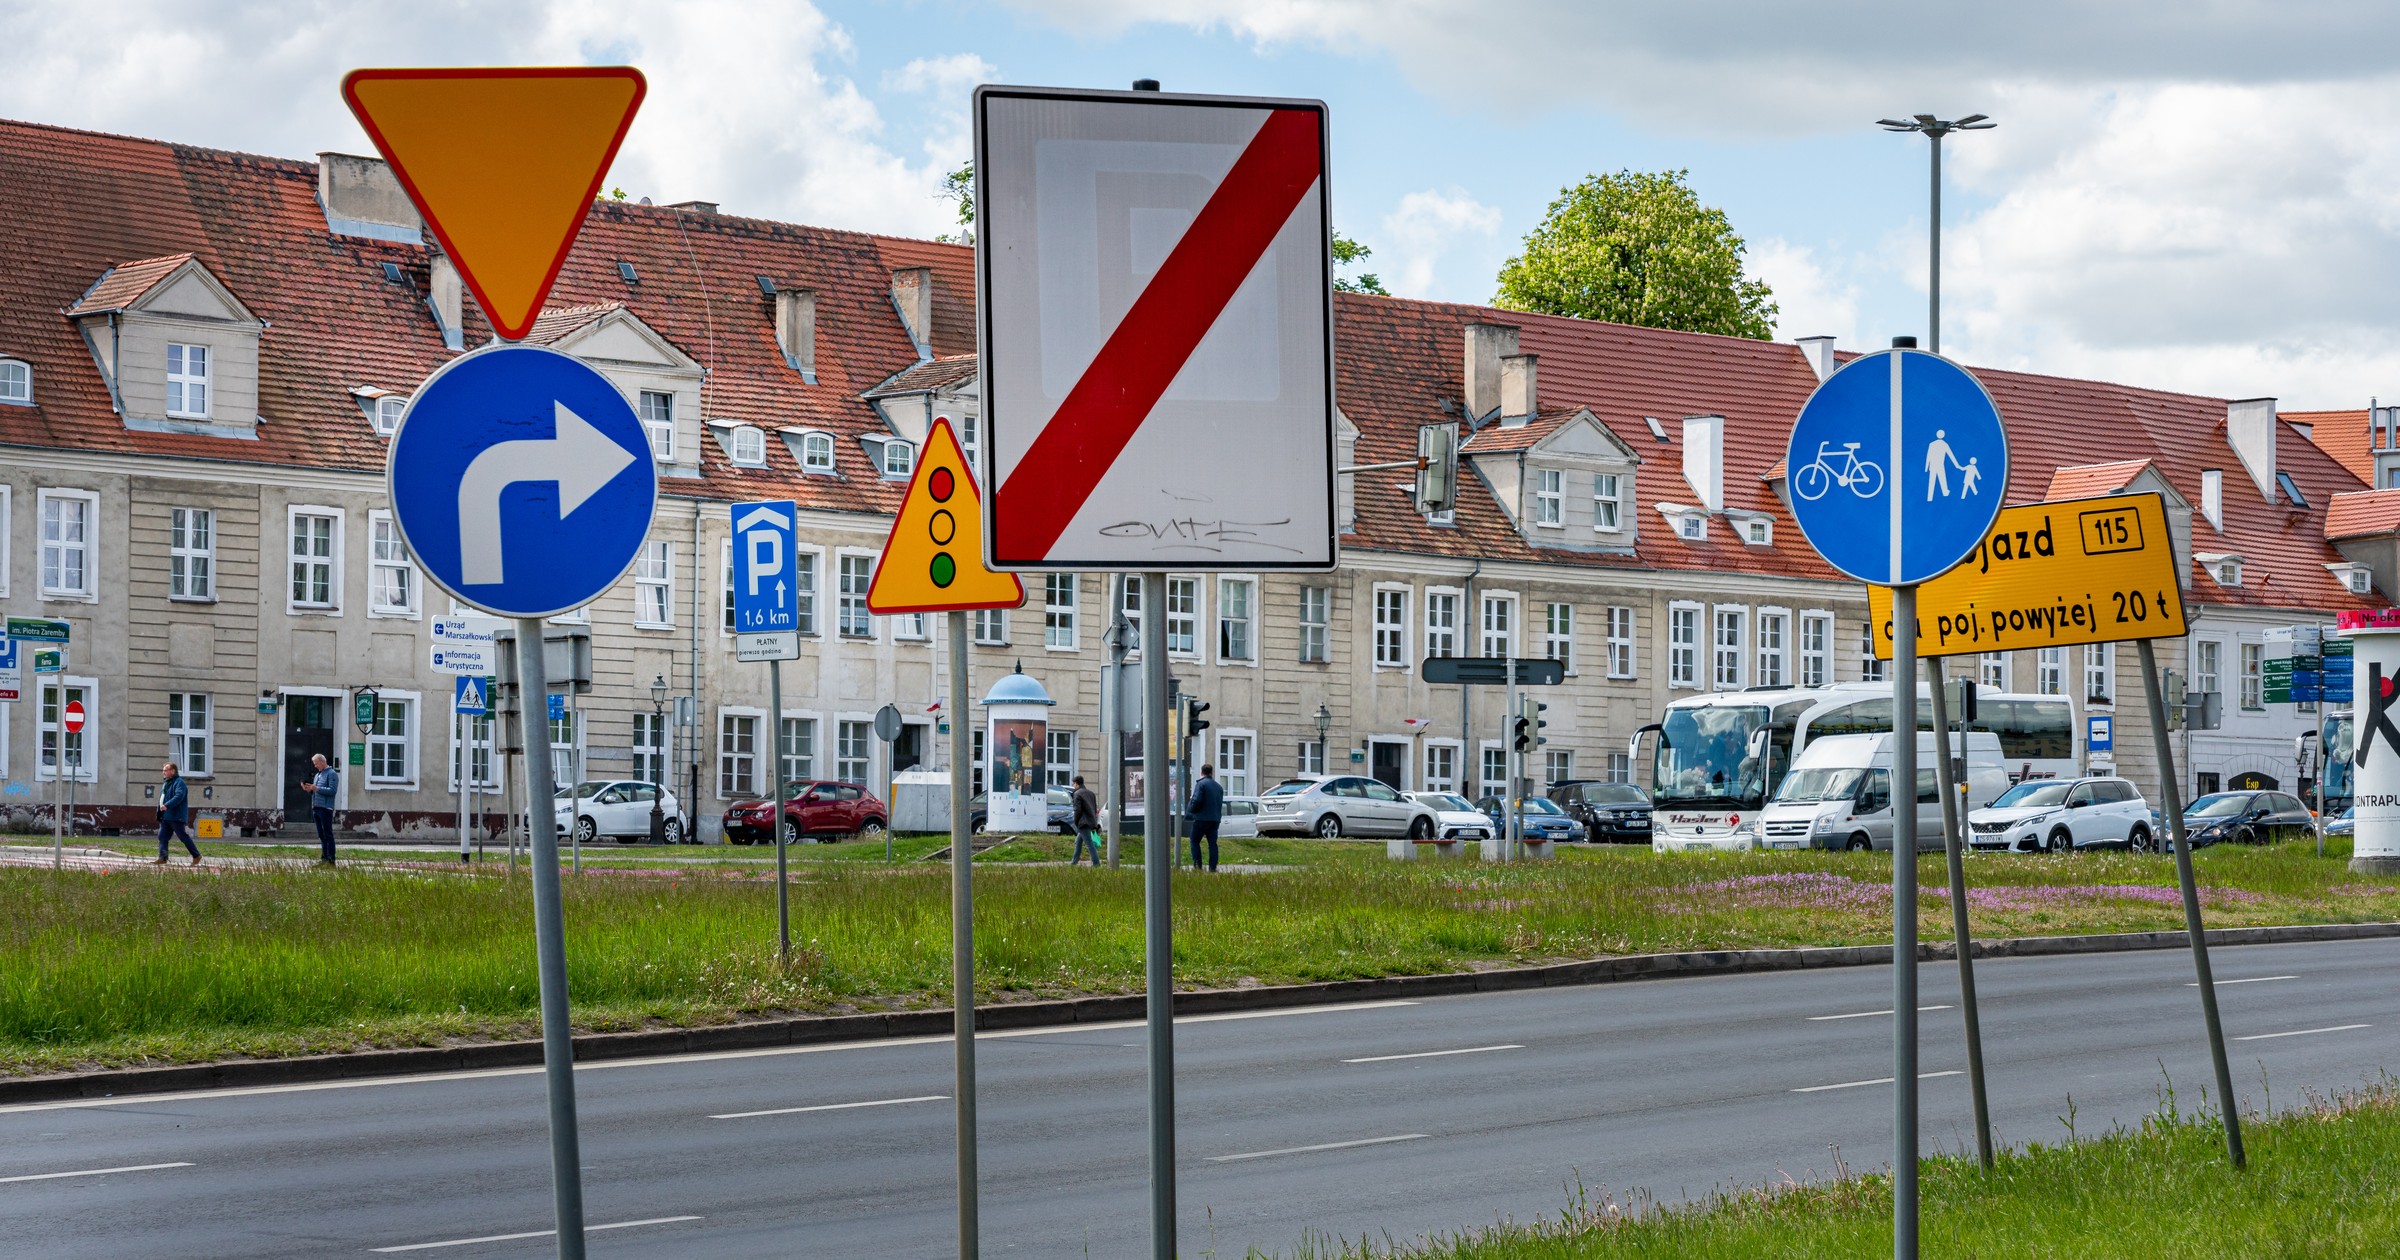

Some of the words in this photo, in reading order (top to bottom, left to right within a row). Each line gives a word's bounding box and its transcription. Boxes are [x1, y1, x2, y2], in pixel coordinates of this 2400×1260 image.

[1962, 515, 2055, 574] jazd
[2094, 516, 2129, 546] 115
[745, 608, 764, 627] 1,6
[770, 608, 790, 625] km
[1937, 603, 1985, 646] poj.
[1991, 593, 2097, 642] powyżej
[2112, 590, 2147, 623] 20
[2156, 590, 2169, 620] t
[2362, 613, 2377, 622] Na
[445, 620, 466, 630] Urząd
[22, 627, 40, 636] Piotra
[41, 628, 65, 637] Zaremby
[445, 631, 494, 641] Marszałkowski
[756, 638, 778, 646] PŁATNY
[445, 651, 481, 661] Informacja
[738, 649, 760, 657] pierwsza
[762, 648, 782, 656] godzina
[445, 661, 484, 671] Turystyczna
[2355, 794, 2400, 808] ONTRAPU
[1669, 813, 1722, 824] Hasler
